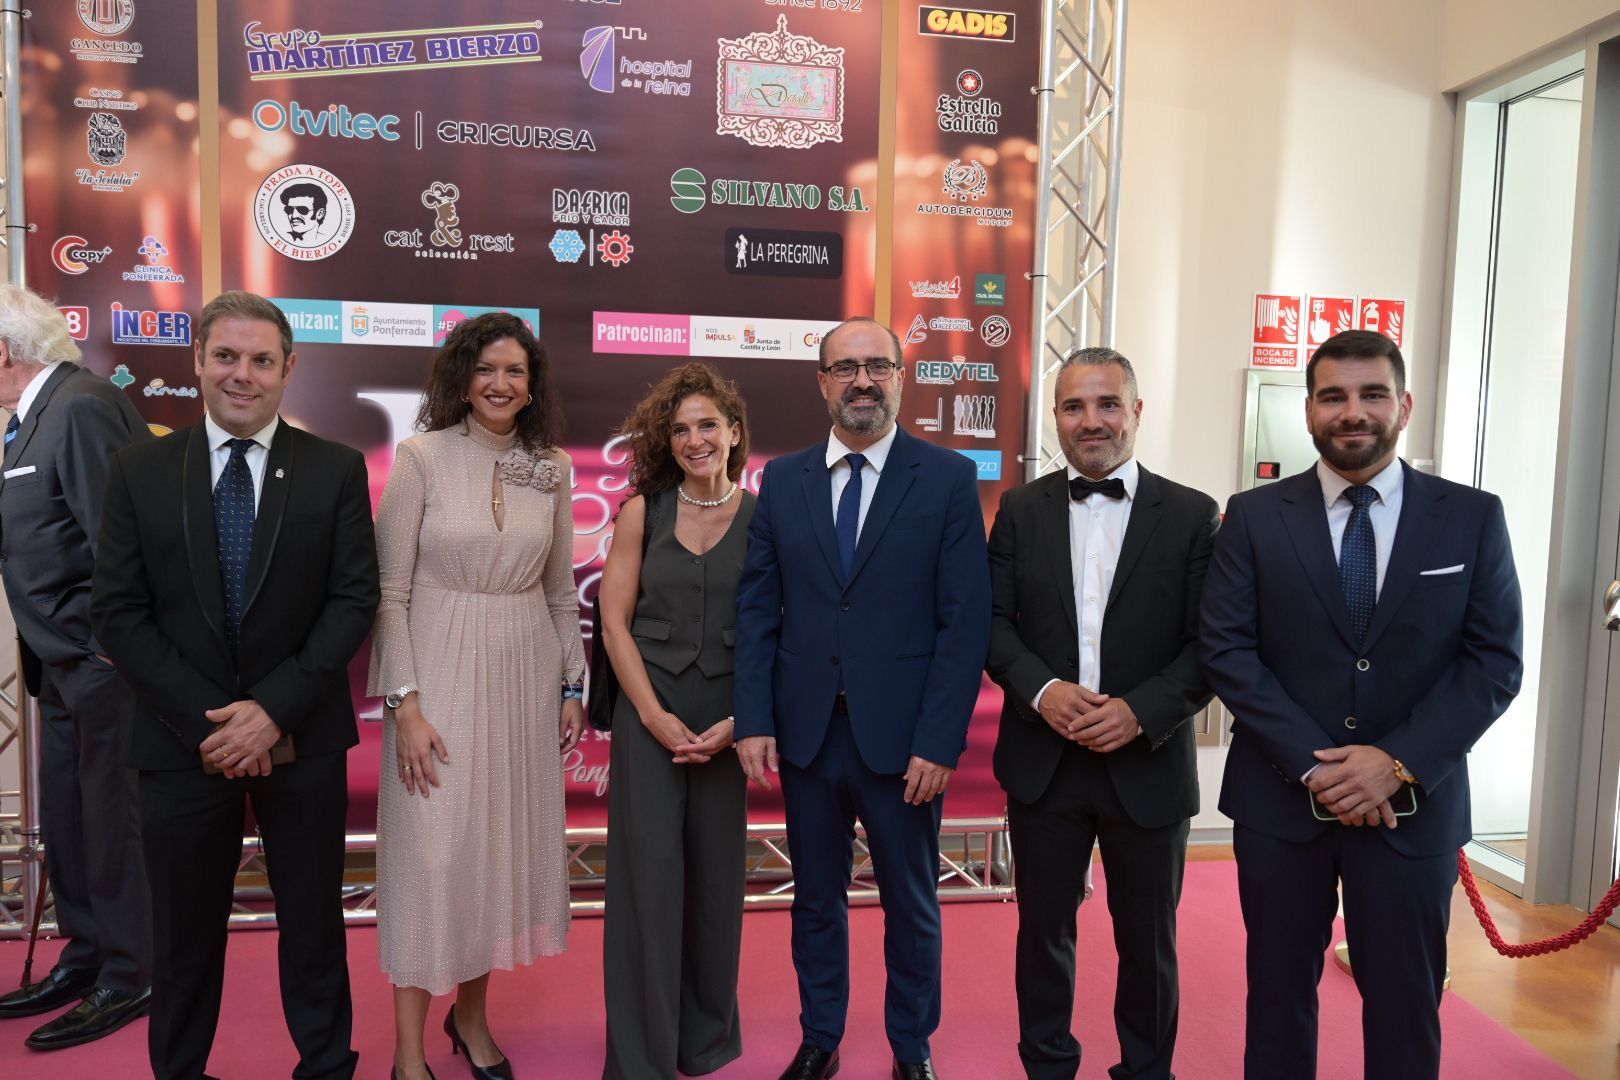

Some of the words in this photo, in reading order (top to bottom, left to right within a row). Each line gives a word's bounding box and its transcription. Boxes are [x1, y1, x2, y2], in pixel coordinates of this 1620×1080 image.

[926, 9, 1008, 38] GADIS
[71, 38, 142, 53] GANCEDO
[244, 21, 321, 51] Grupo
[247, 40, 416, 73] MARTÍNEZ
[425, 32, 540, 61] BIERZO
[619, 56, 692, 78] hospital
[621, 78, 633, 88] de
[634, 79, 642, 89] la
[645, 80, 691, 96] reina
[937, 94, 1001, 116] Estrella
[289, 101, 401, 140] tvitec
[437, 120, 596, 152] CRICURSA
[938, 113, 998, 134] Galicia
[264, 167, 302, 192] PRADA
[306, 167, 314, 176] A
[318, 169, 347, 197] TOPE
[552, 188, 631, 218] DAFRICA
[711, 178, 821, 209] SILVANO
[827, 186, 870, 212] S.A.
[582, 215, 591, 225] Y
[592, 215, 631, 227] CALOR
[916, 203, 1013, 218] AUTOBERGIDUM
[274, 239, 289, 254] EL
[291, 242, 338, 259] BIERZO
[384, 229, 422, 248] cat
[469, 232, 514, 253] rest
[415, 249, 478, 261] selección
[750, 243, 764, 262] LA
[767, 243, 829, 265] PEREGRINA
[122, 272, 184, 283] PONFERRADA
[283, 311, 339, 331] nizan:
[372, 316, 426, 329] Ayuntamiento
[372, 325, 427, 338] Ponferrada
[597, 323, 687, 344] Patrocinan:
[1254, 356, 1295, 366] INCENDIO
[1256, 348, 1280, 357] BOCA
[1282, 349, 1294, 357] DE
[915, 360, 999, 382] REDYTEL
